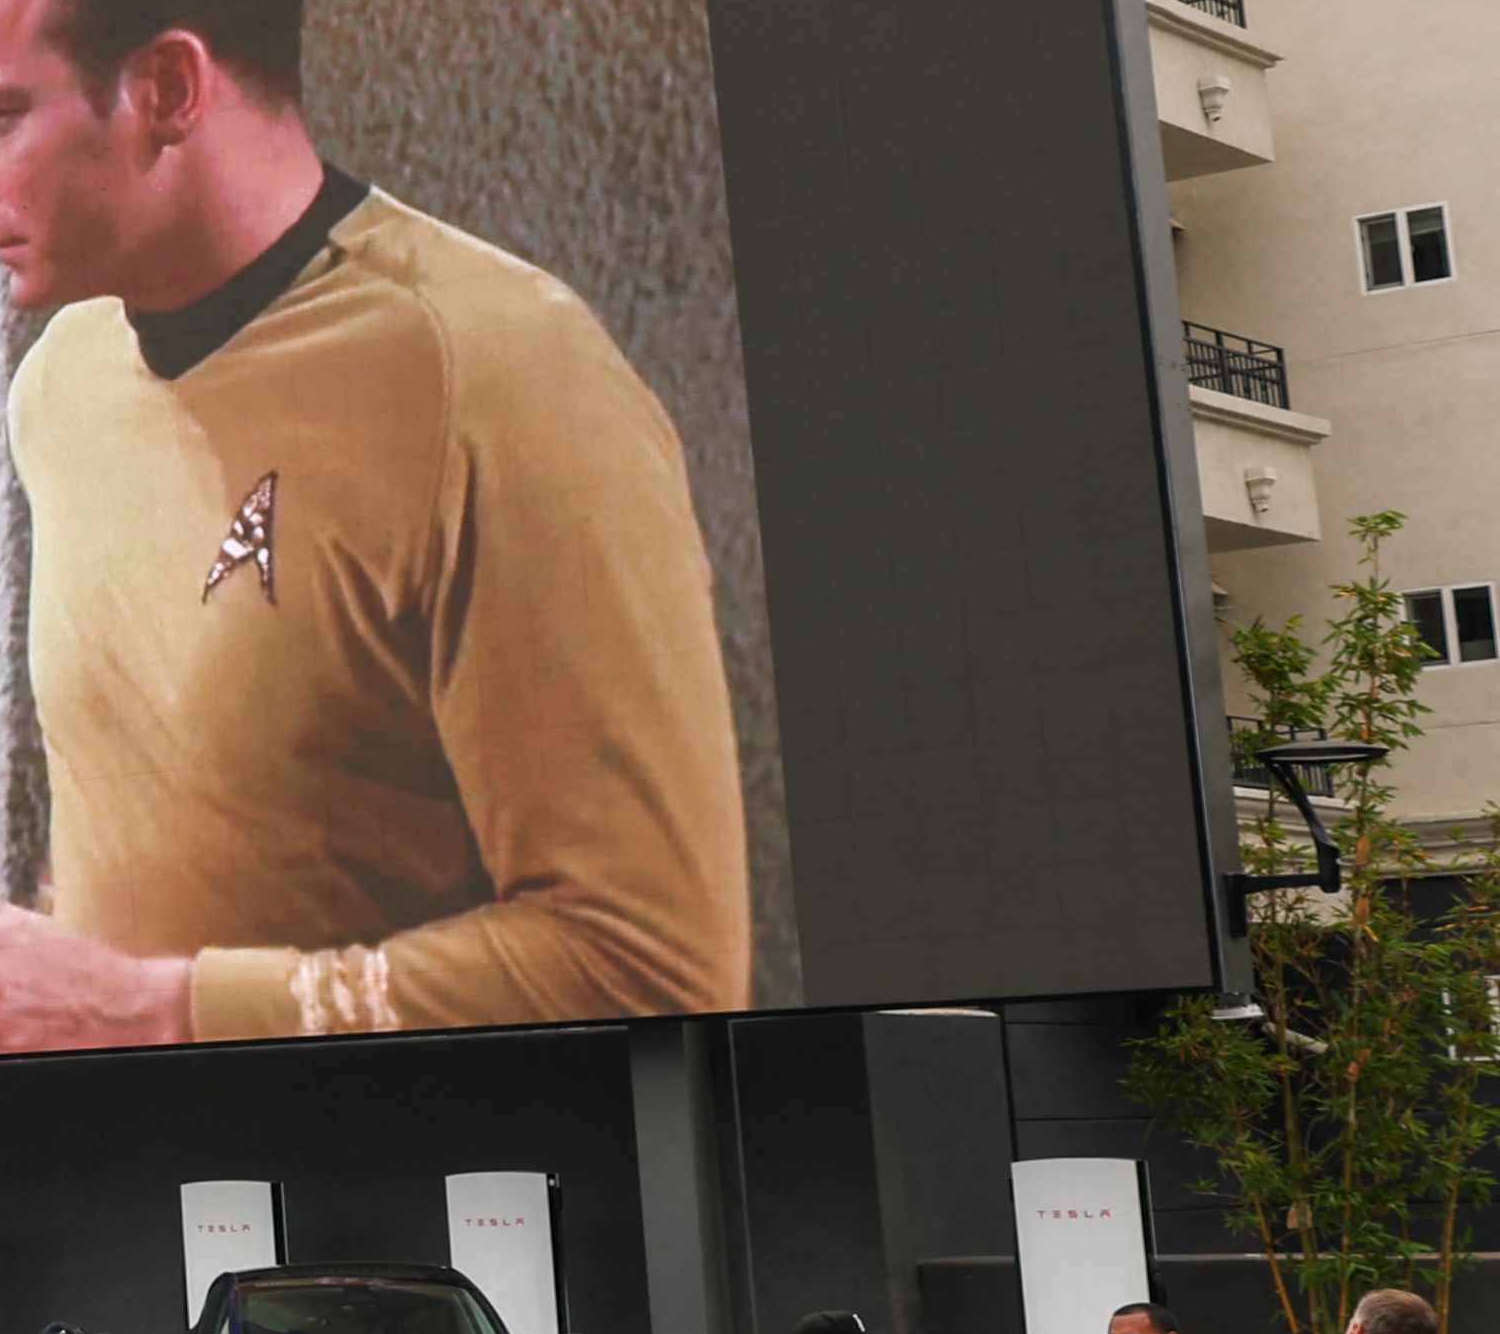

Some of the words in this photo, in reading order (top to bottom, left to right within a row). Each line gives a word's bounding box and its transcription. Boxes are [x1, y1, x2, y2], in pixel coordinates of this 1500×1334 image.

[1036, 1209, 1112, 1219] TESLA
[464, 1217, 526, 1227] TESLA
[197, 1223, 252, 1233] TESLA
